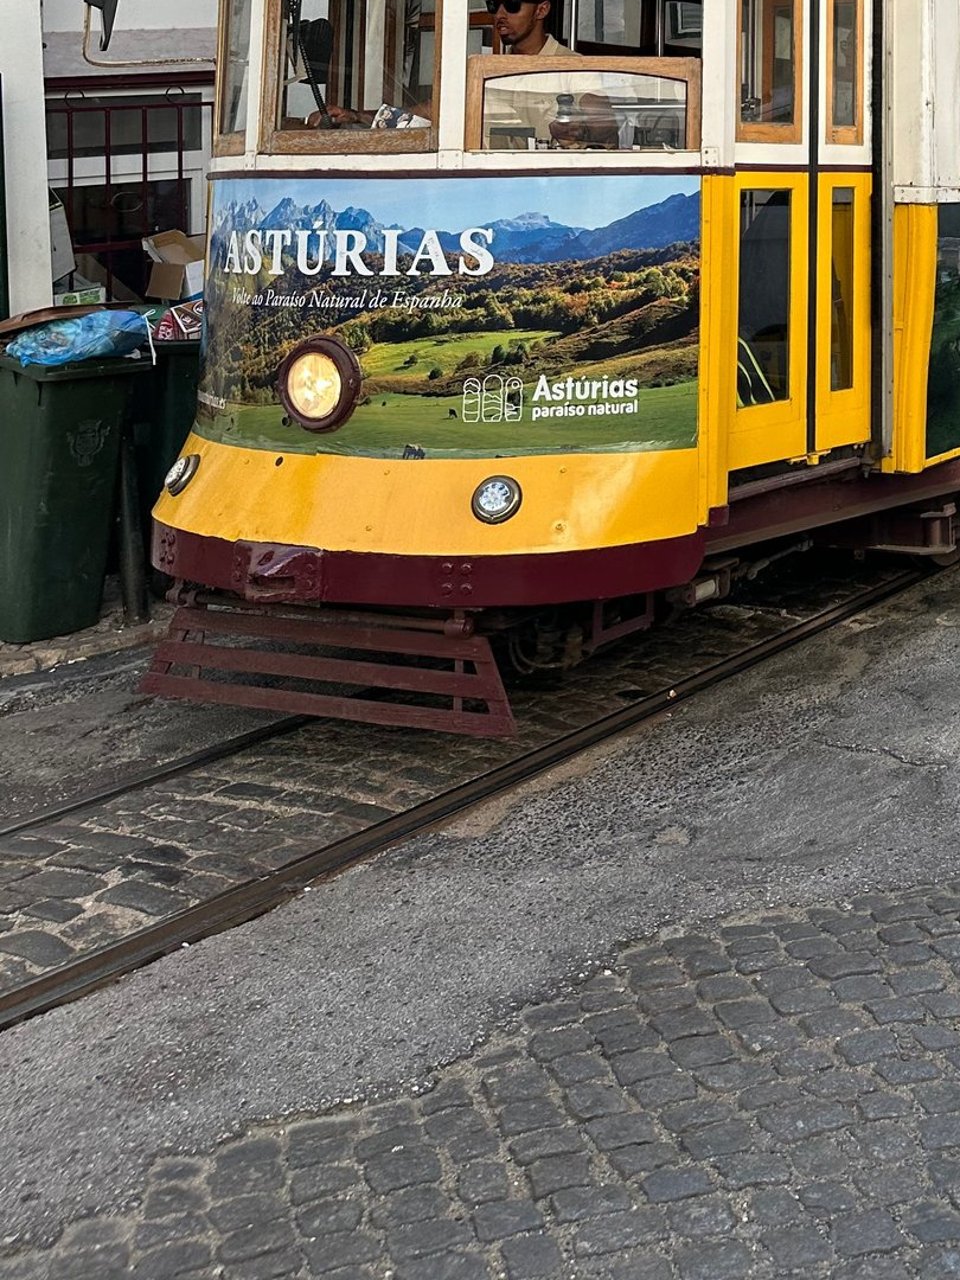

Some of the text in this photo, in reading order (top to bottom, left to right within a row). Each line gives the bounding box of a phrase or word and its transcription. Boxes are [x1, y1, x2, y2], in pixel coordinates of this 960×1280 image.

[223, 220, 495, 277] ASTÚRIAS
[231, 286, 463, 315] Volte ao Paraíso Natural de Espanha
[532, 373, 639, 402] Astúrias
[531, 399, 639, 421] paraíso natural
